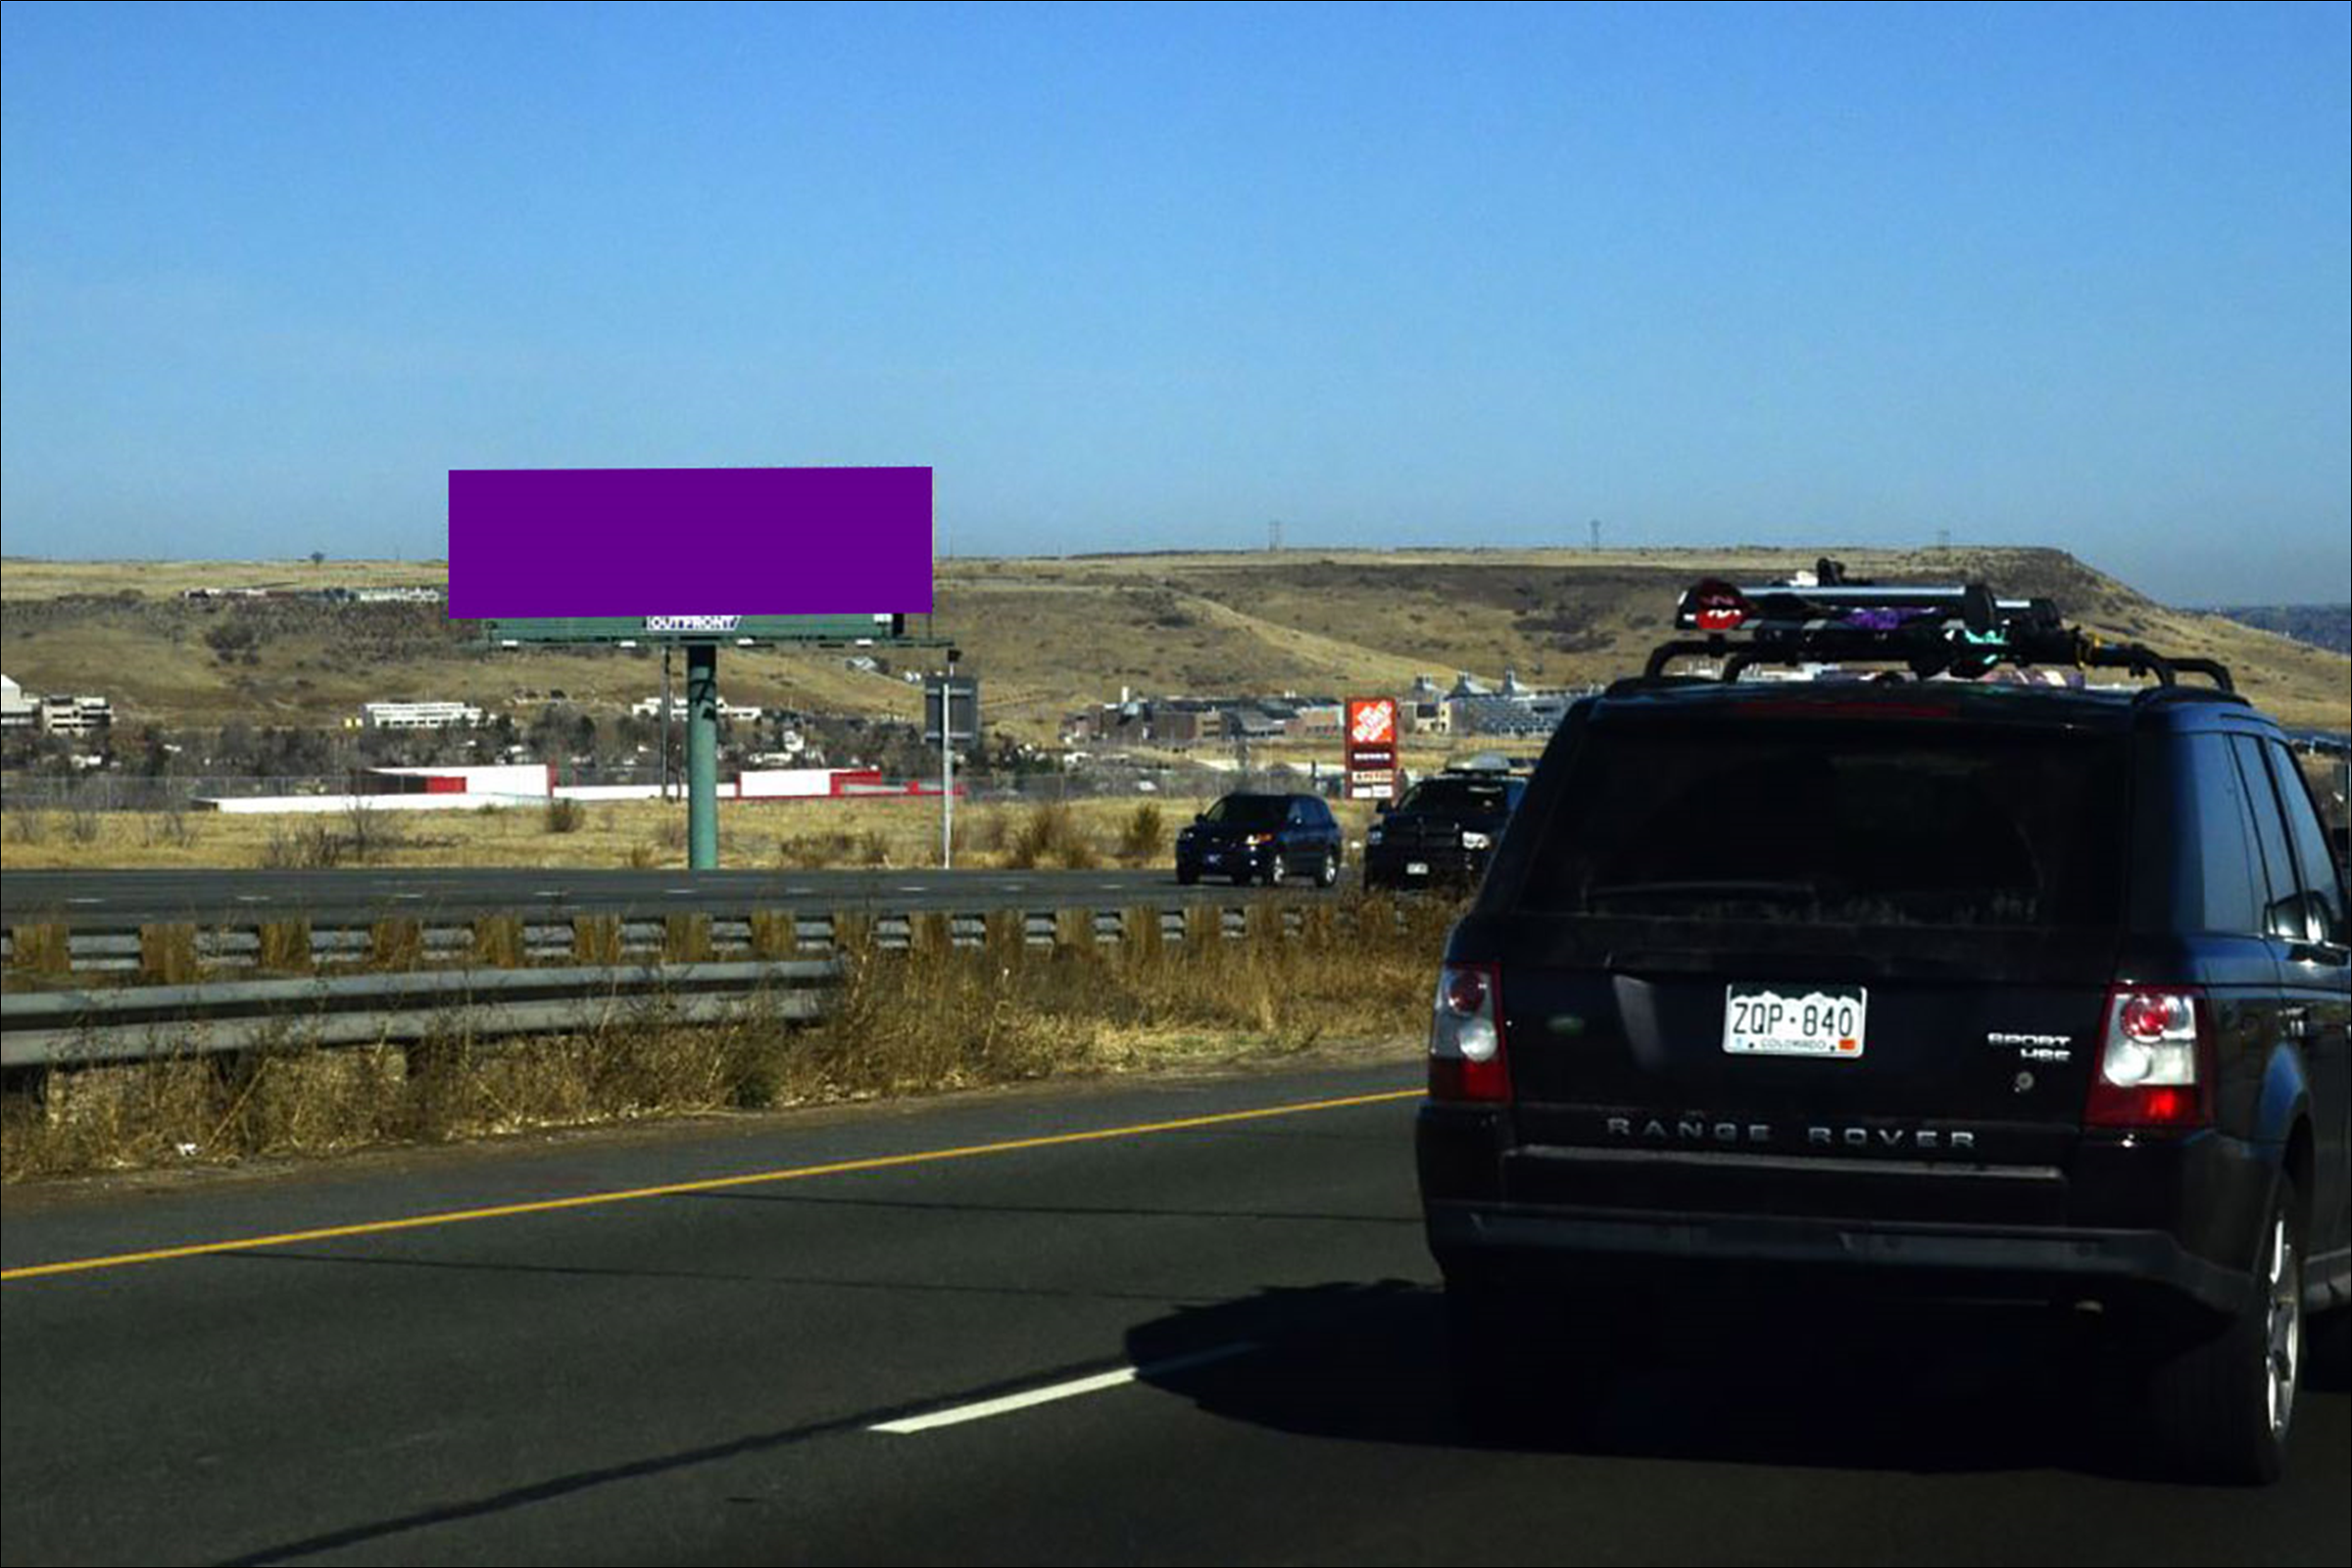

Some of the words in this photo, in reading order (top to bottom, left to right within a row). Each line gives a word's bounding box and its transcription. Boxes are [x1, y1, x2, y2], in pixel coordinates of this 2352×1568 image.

[648, 616, 736, 630] OUTFRONT
[1987, 1032, 2072, 1047] SPORT
[1607, 1118, 1770, 1142] RANGE
[1808, 1127, 1974, 1148] ROVER
